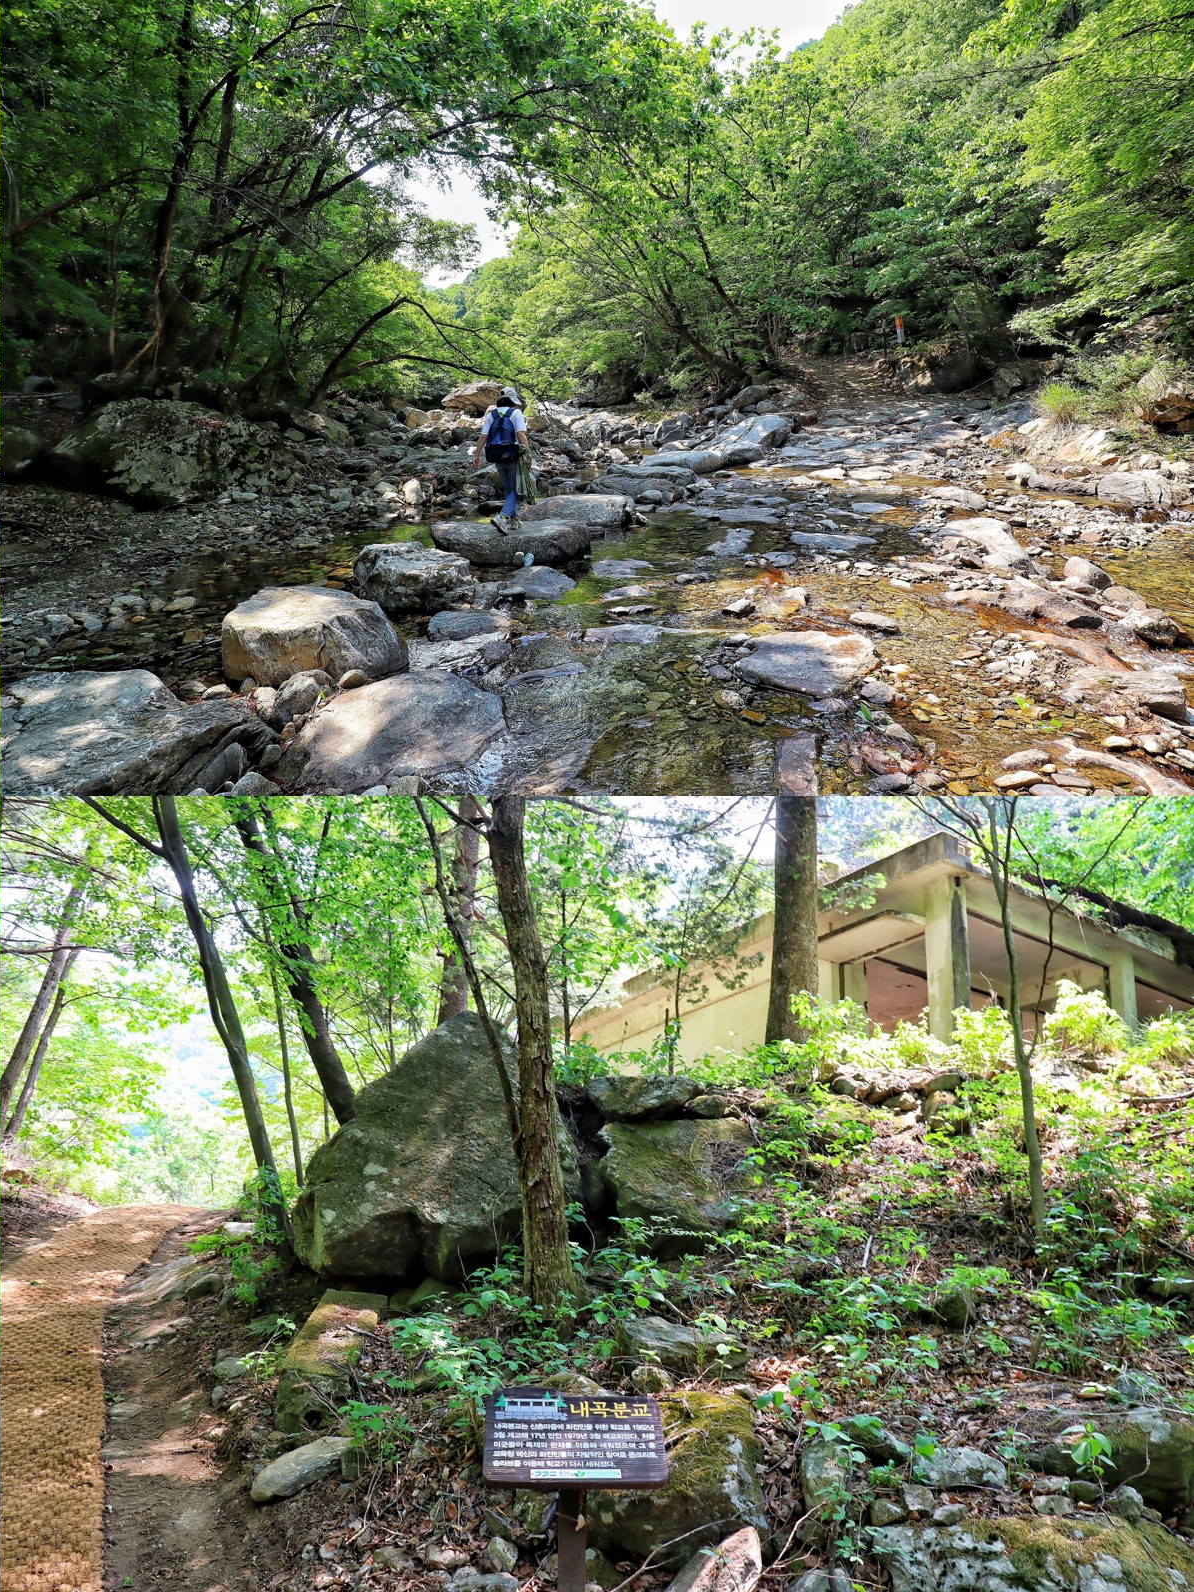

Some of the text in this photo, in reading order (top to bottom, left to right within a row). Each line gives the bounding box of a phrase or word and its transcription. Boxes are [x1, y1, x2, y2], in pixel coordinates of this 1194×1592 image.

[569, 1400, 653, 1419] 내곡분교
[493, 1441, 523, 1449] 미군들이
[492, 1450, 515, 1458] 교육청
[546, 1460, 568, 1468] 학교가
[569, 1460, 584, 1468] 다시
[585, 1460, 616, 1468] 세워졌다.
